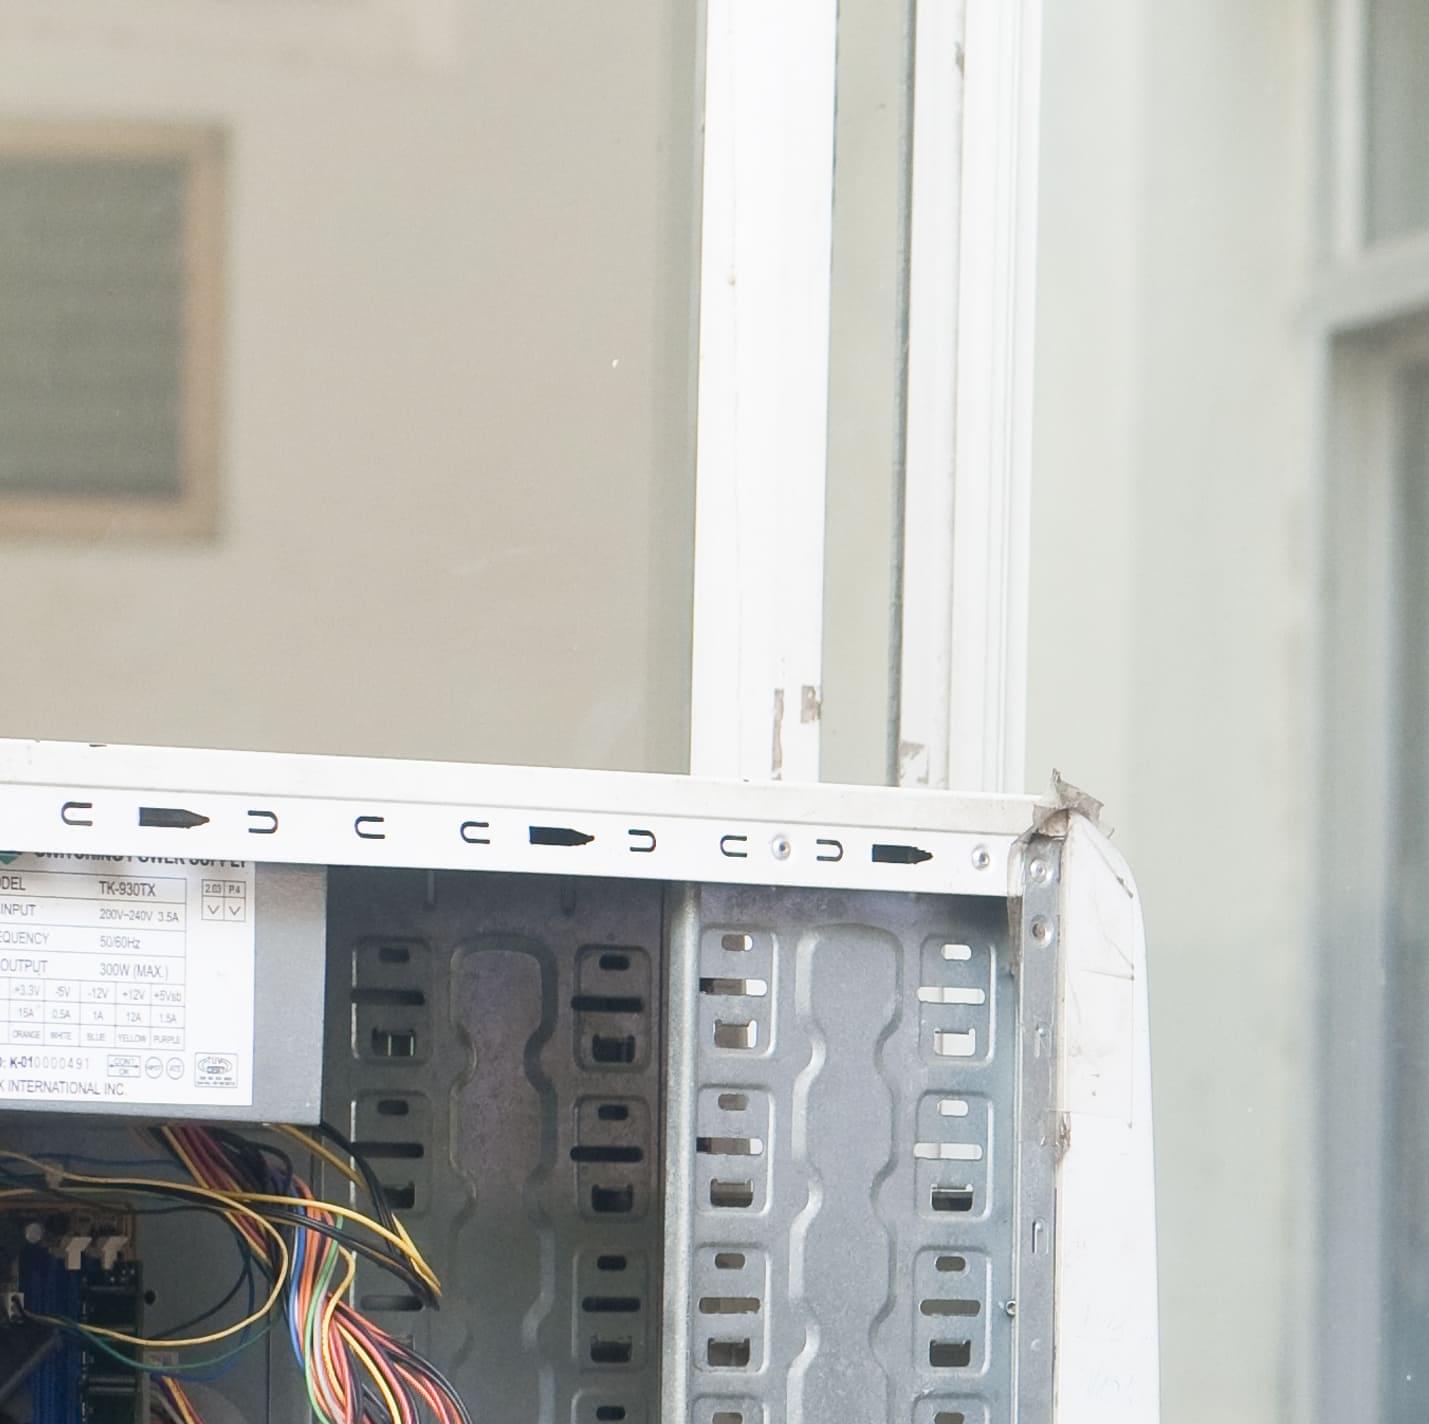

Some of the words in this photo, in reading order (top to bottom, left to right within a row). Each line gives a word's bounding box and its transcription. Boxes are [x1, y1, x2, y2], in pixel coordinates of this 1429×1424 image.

[0, 876, 26, 891] DEL
[98, 880, 156, 897] TK-930TX
[99, 935, 141, 949] 50/60Hz
[0, 958, 48, 973] OUTPUT
[99, 962, 130, 976] 300W
[8, 1079, 101, 1095] INTERNATIONAL
